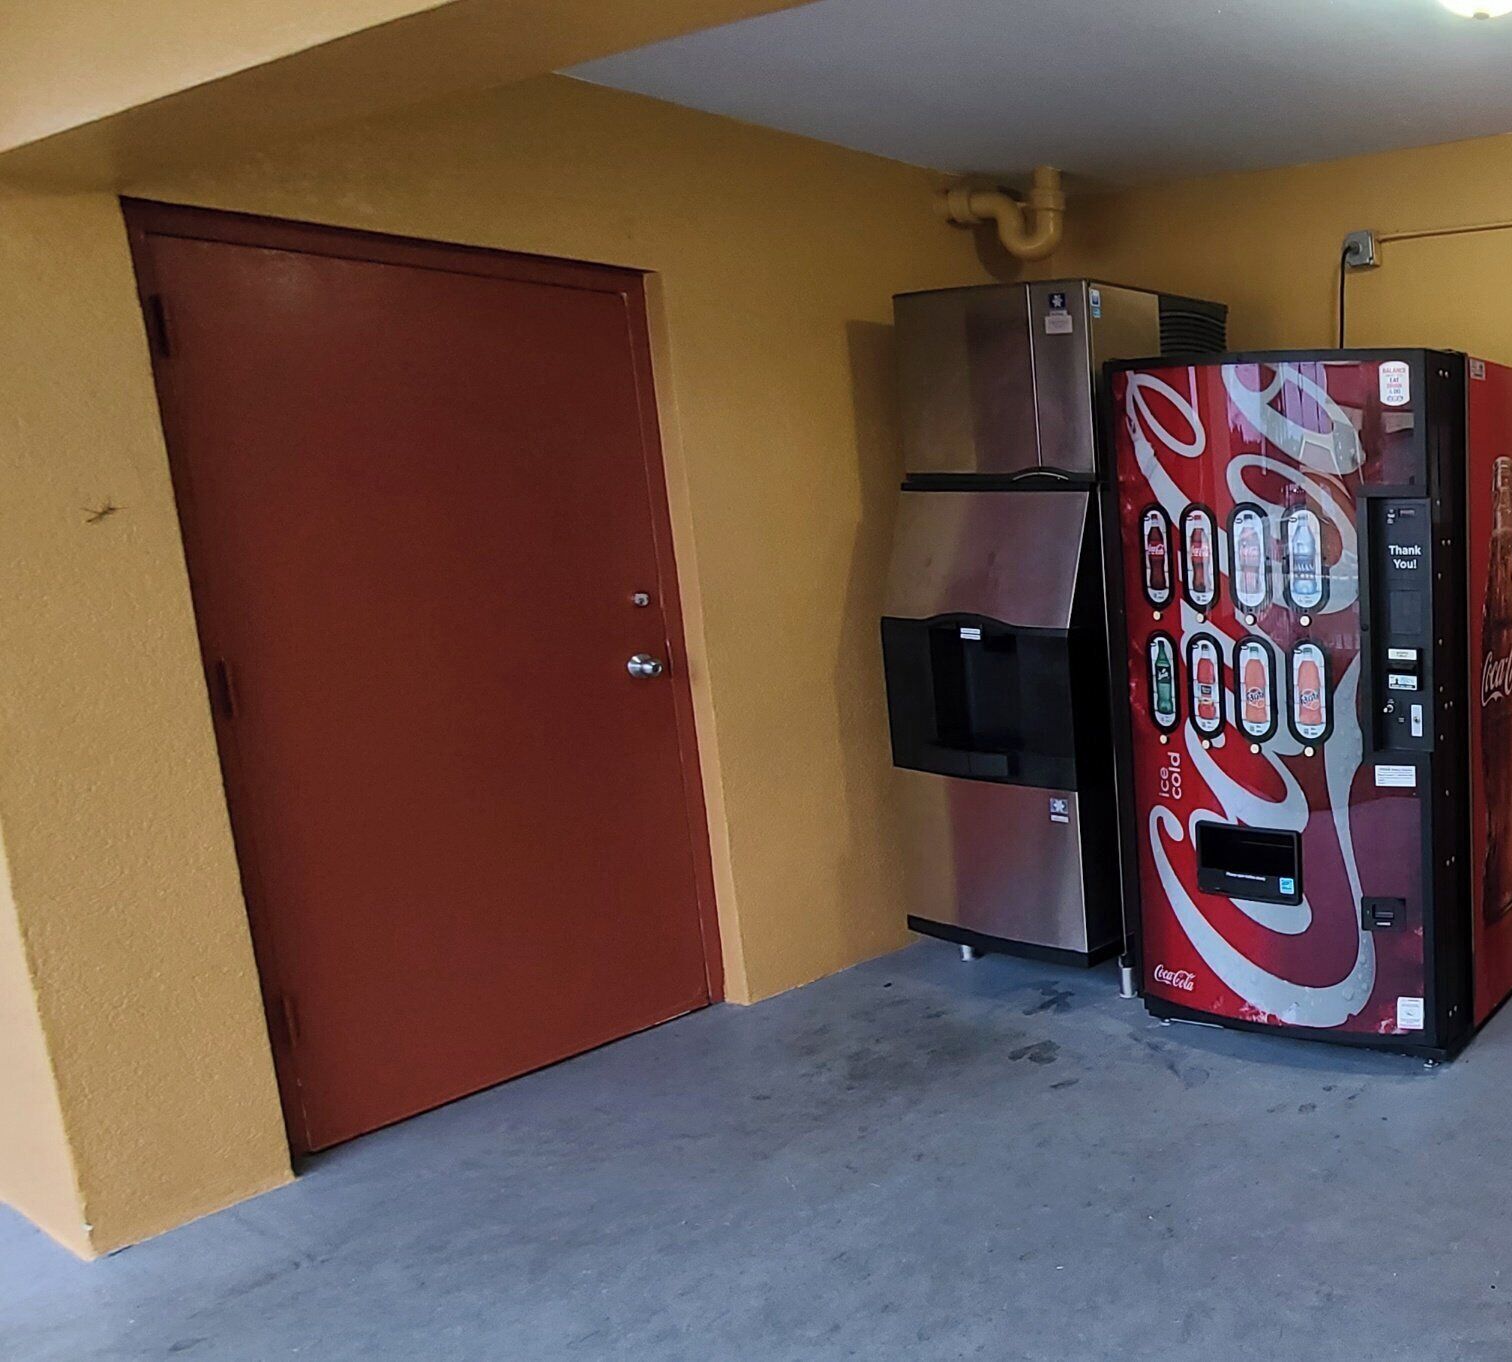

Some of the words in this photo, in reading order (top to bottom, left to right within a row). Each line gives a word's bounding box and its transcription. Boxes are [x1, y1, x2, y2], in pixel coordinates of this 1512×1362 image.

[1388, 544, 1422, 556] Thank
[1393, 559, 1417, 569] You!
[1158, 767, 1170, 798] ice
[1167, 751, 1182, 800] cold
